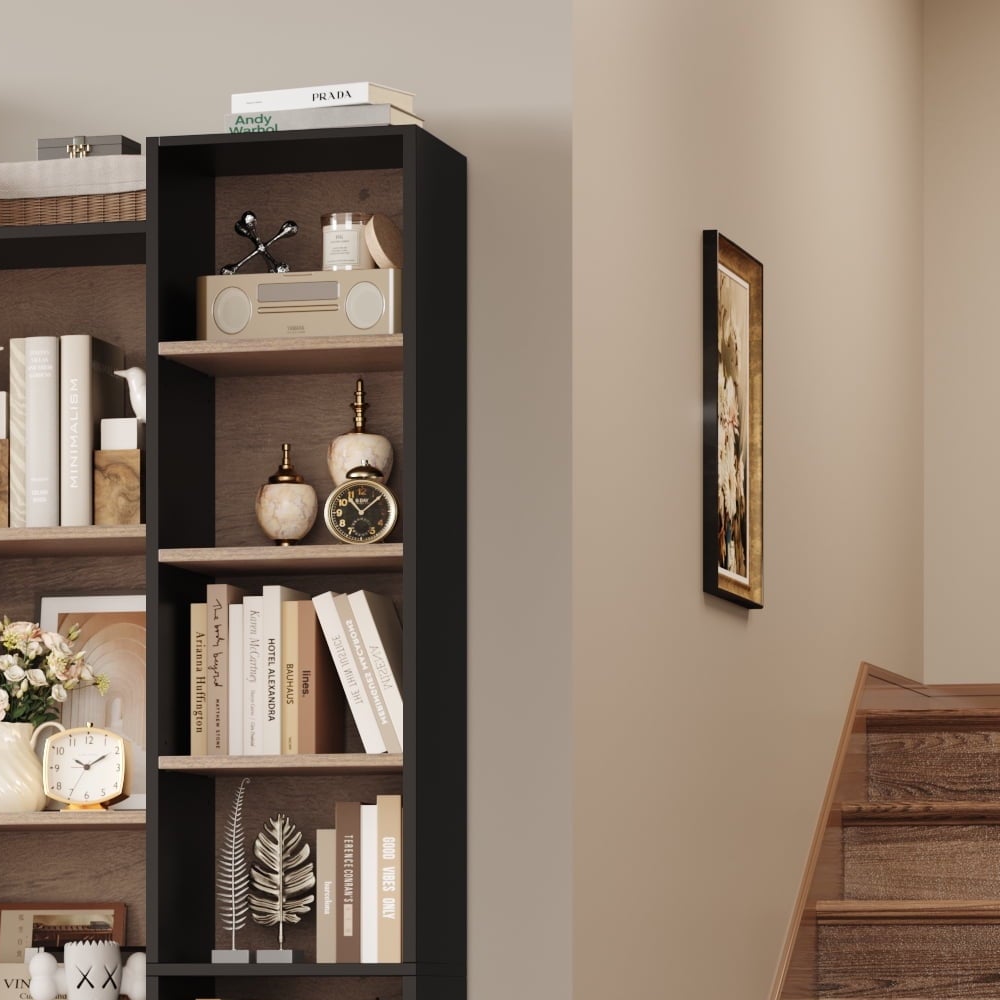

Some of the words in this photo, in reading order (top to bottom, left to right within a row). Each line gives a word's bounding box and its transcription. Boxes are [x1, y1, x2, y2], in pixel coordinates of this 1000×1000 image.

[312, 90, 352, 102] PRADA
[235, 113, 272, 129] Andy
[69, 378, 80, 488] MINIMALISM
[212, 598, 222, 621] The
[196, 632, 206, 672] Arianna
[268, 638, 276, 668] HOTEL
[268, 669, 276, 722] ALEXANDRA
[286, 663, 294, 705] BAUHAUS
[302, 670, 311, 698] lines.
[193, 676, 206, 733] Huffington
[56, 747, 64, 756] 10
[85, 736, 94, 744] 12
[114, 746, 120, 755] 2
[54, 764, 60, 772] 9
[56, 782, 62, 790] 8
[84, 792, 90, 800] 6
[344, 835, 354, 867] TERENCE
[382, 836, 396, 860] GOOD
[382, 866, 396, 892] VIBES
[382, 898, 396, 920] ONLY
